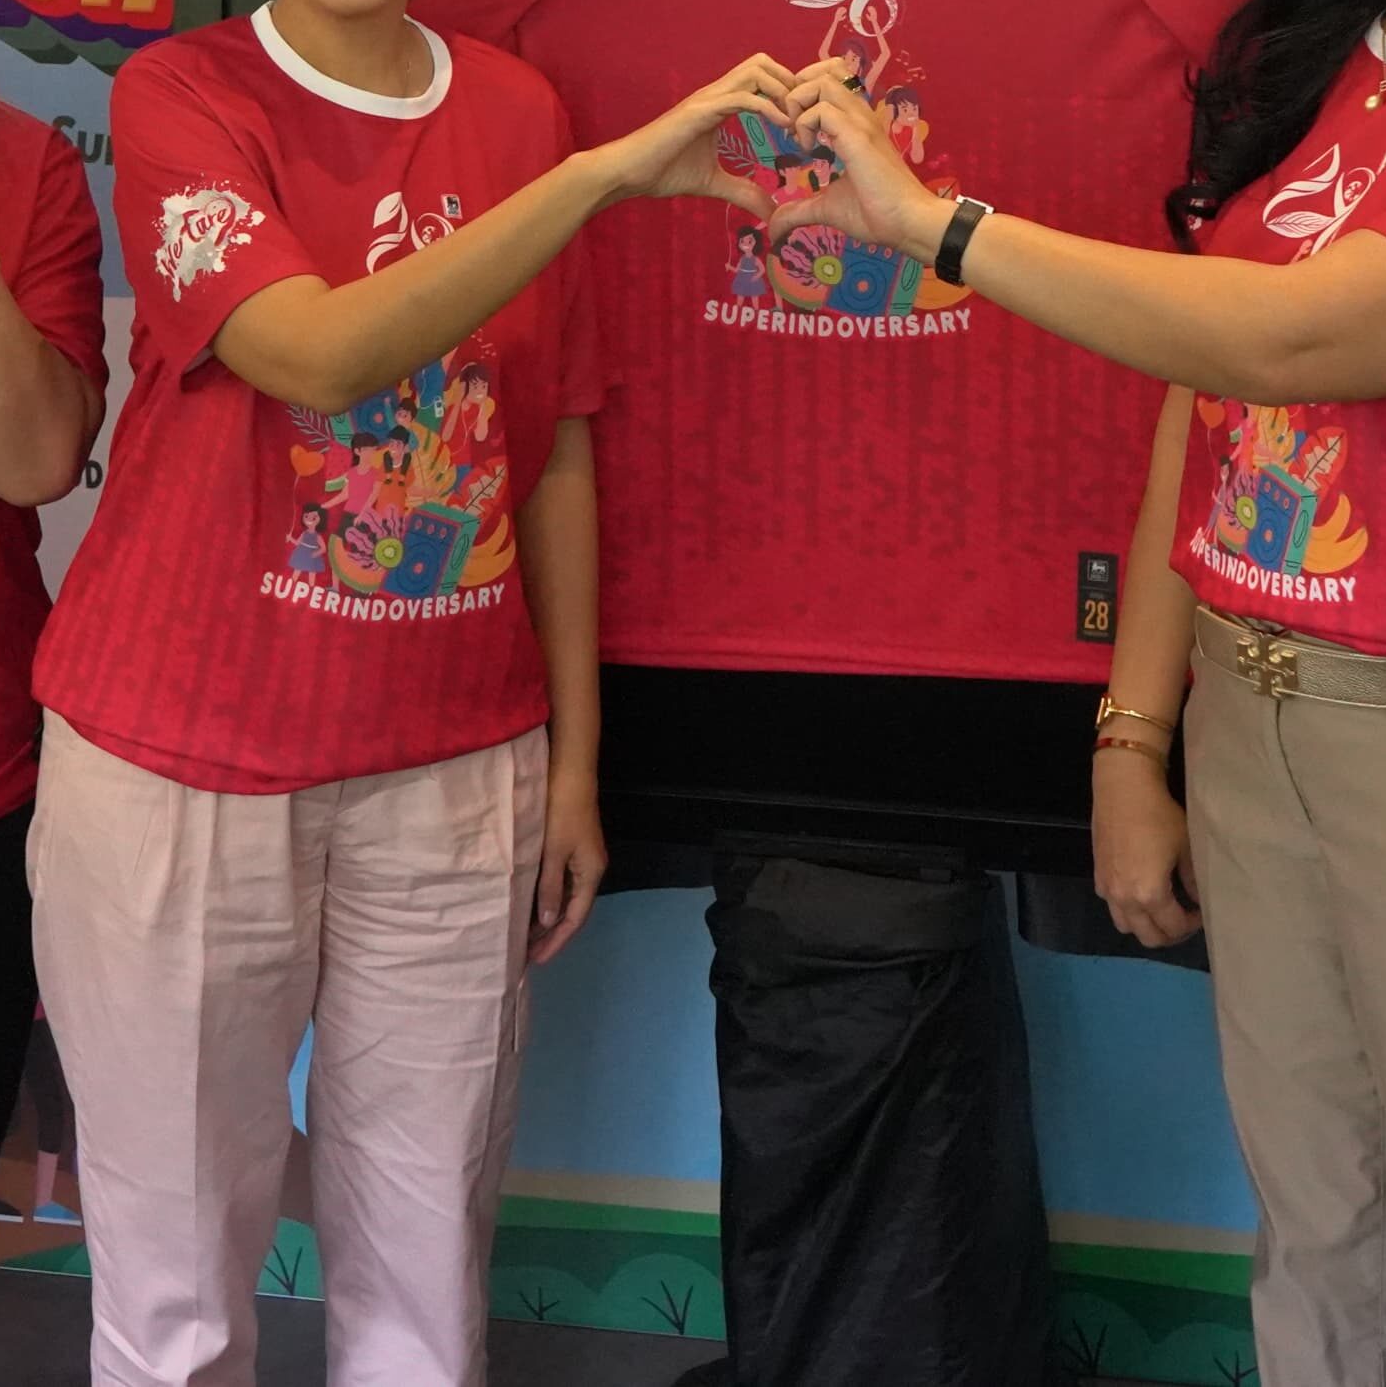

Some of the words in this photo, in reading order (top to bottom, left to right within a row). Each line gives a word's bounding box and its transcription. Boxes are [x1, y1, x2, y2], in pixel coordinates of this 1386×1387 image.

[704, 299, 971, 340] SUPERINDOVERSARY
[259, 570, 506, 622] SUPERINDOVERSARY
[1084, 599, 1110, 631] 28
